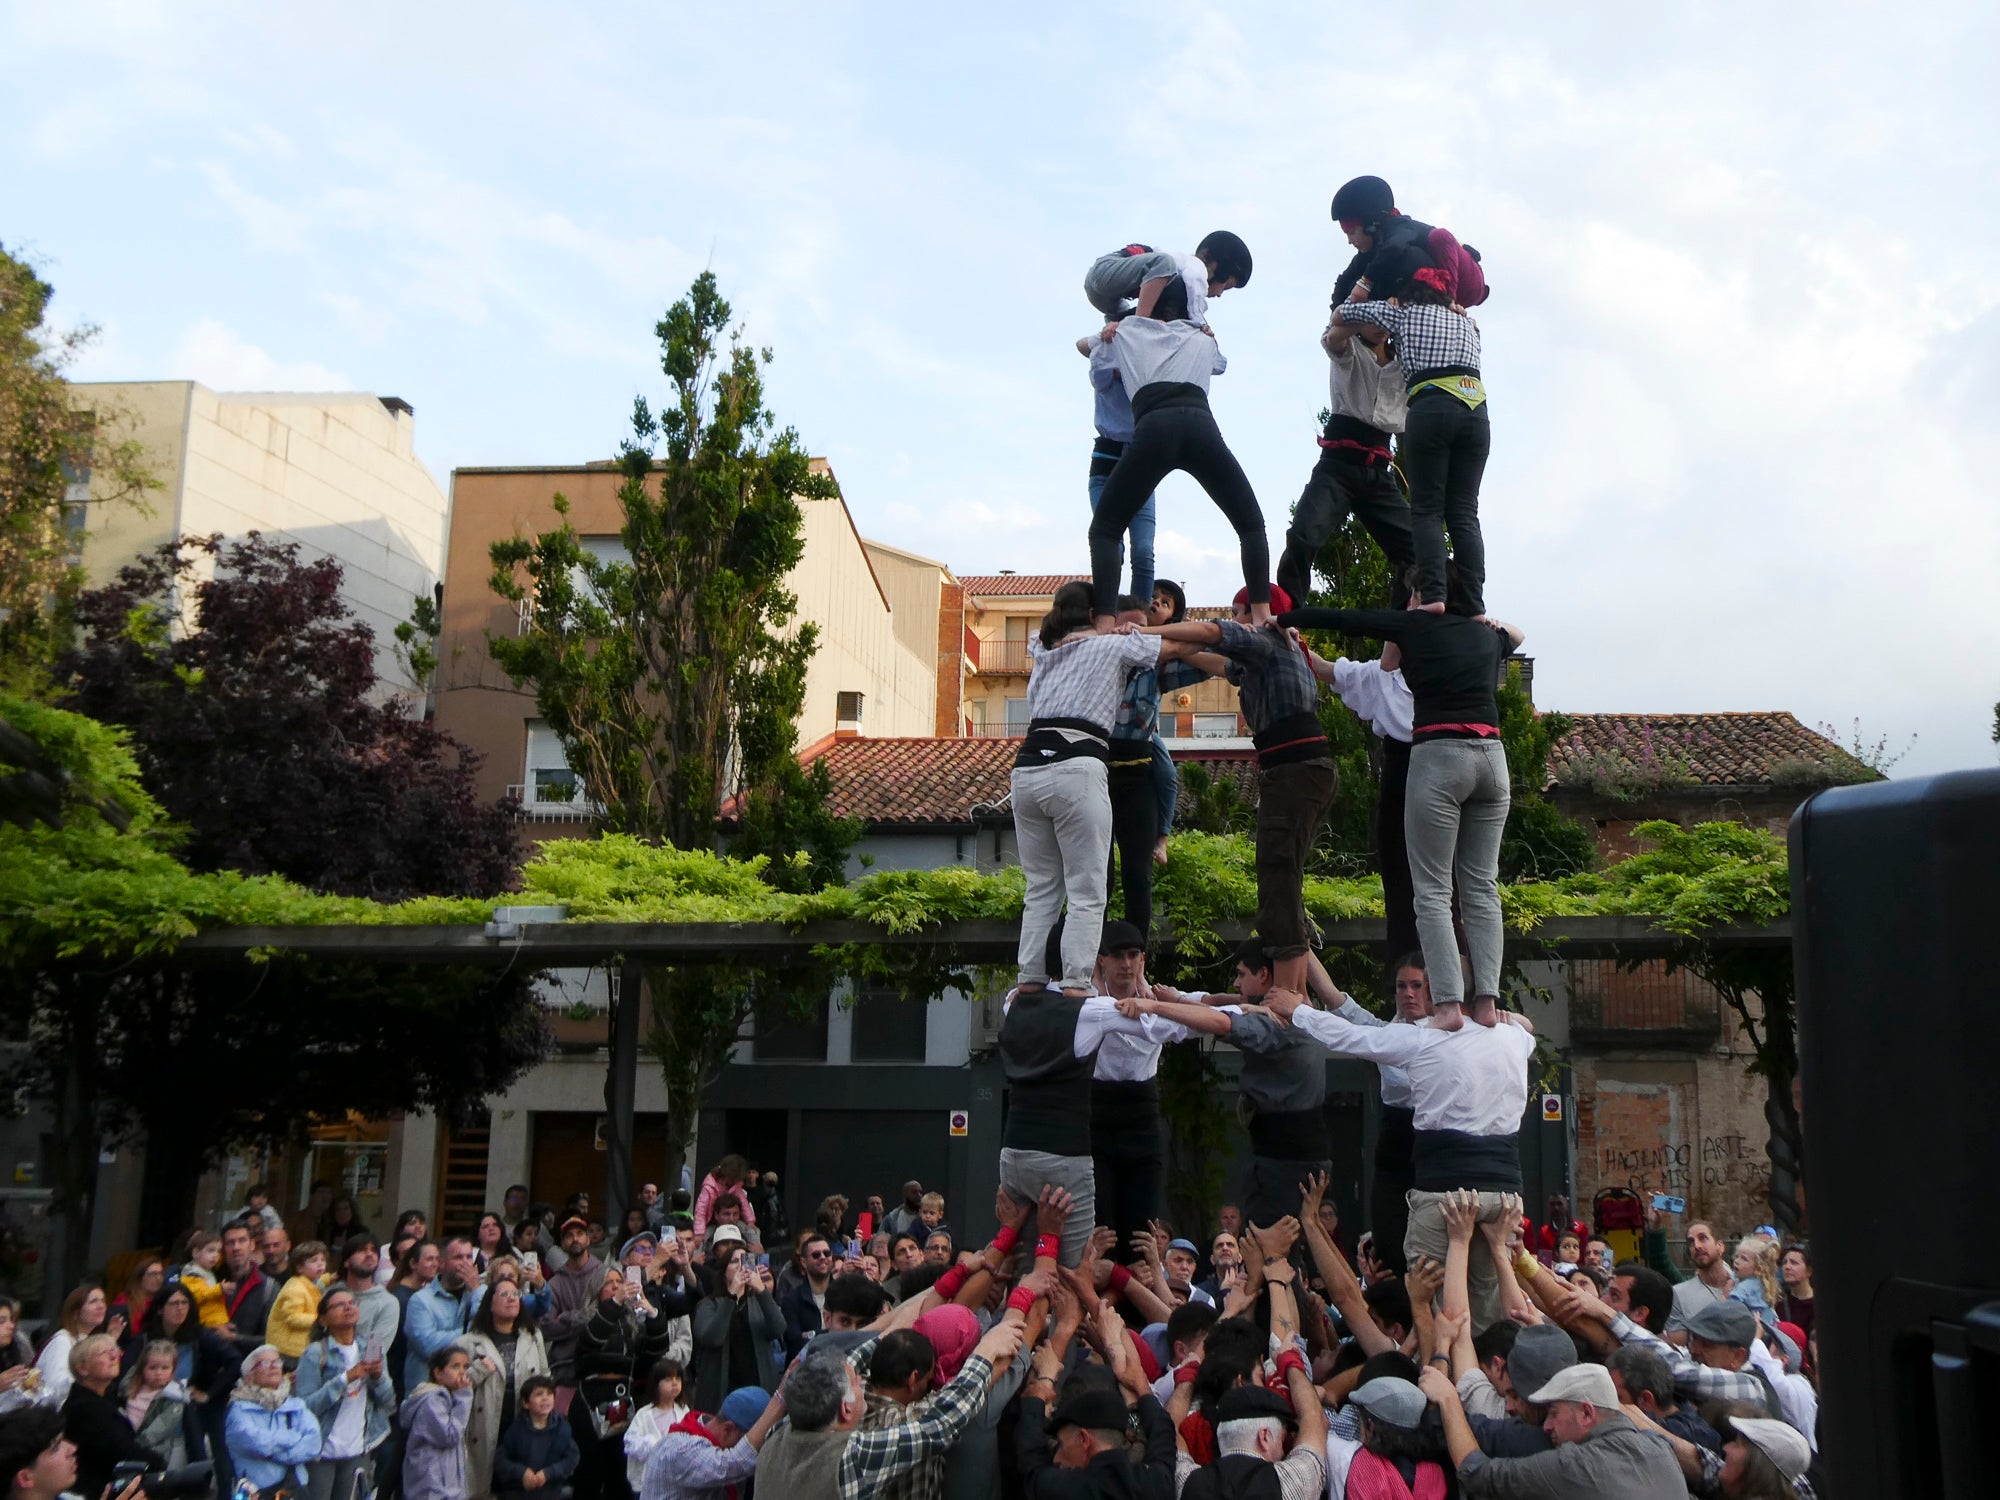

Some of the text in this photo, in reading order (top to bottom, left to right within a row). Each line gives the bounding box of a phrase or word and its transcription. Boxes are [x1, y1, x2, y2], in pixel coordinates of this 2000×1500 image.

[1703, 1135, 1750, 1161] ARTE
[1629, 1173, 1655, 1192] DE
[1661, 1169, 1692, 1189] MIS
